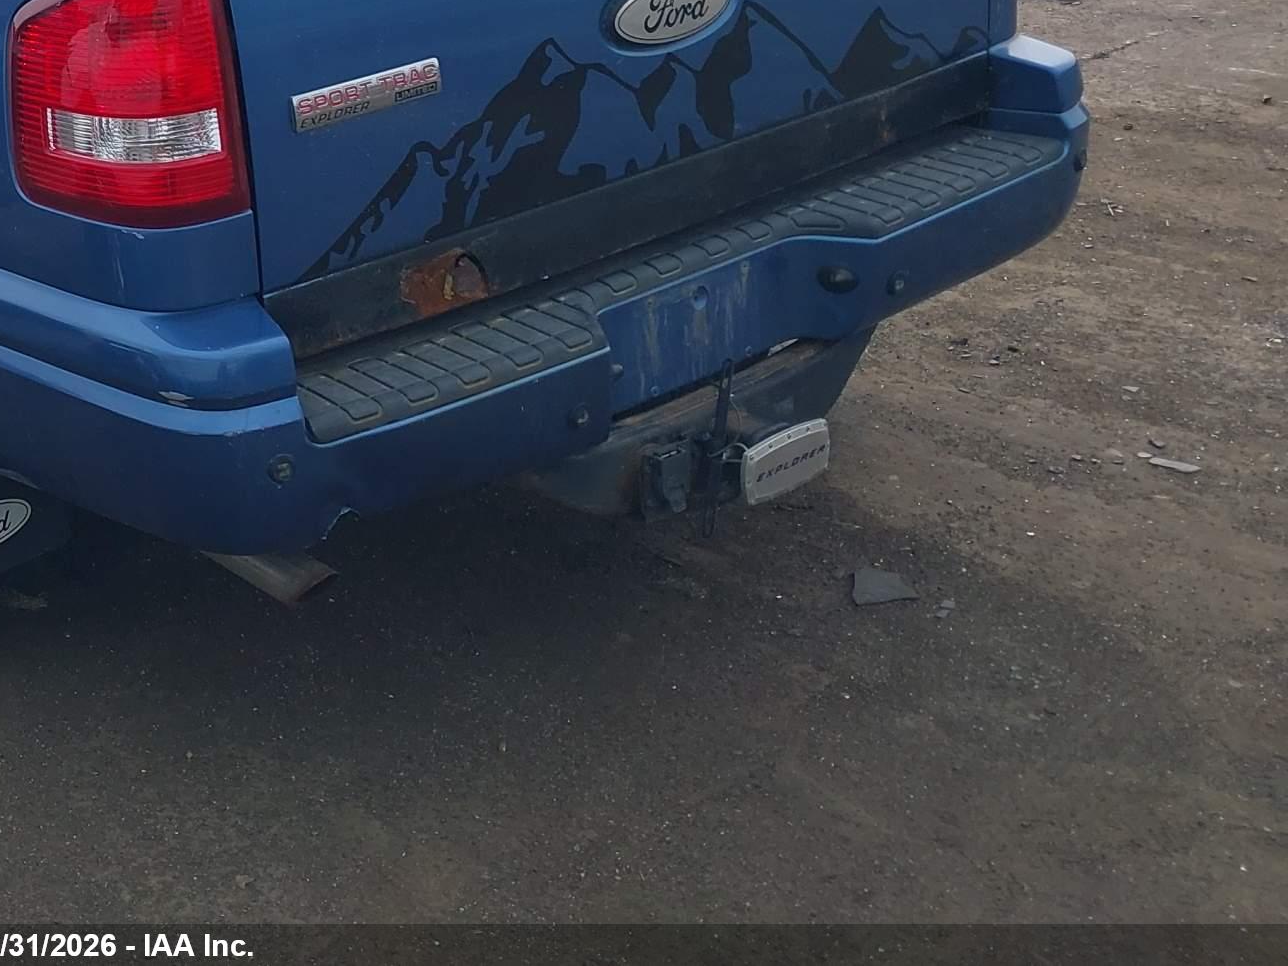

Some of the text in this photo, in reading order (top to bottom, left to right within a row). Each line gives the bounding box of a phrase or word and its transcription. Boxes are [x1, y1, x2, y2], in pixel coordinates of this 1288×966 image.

[297, 63, 439, 115] SPORT TRAC
[300, 101, 371, 130] EXPLORER
[756, 444, 826, 483] EXPLORER
